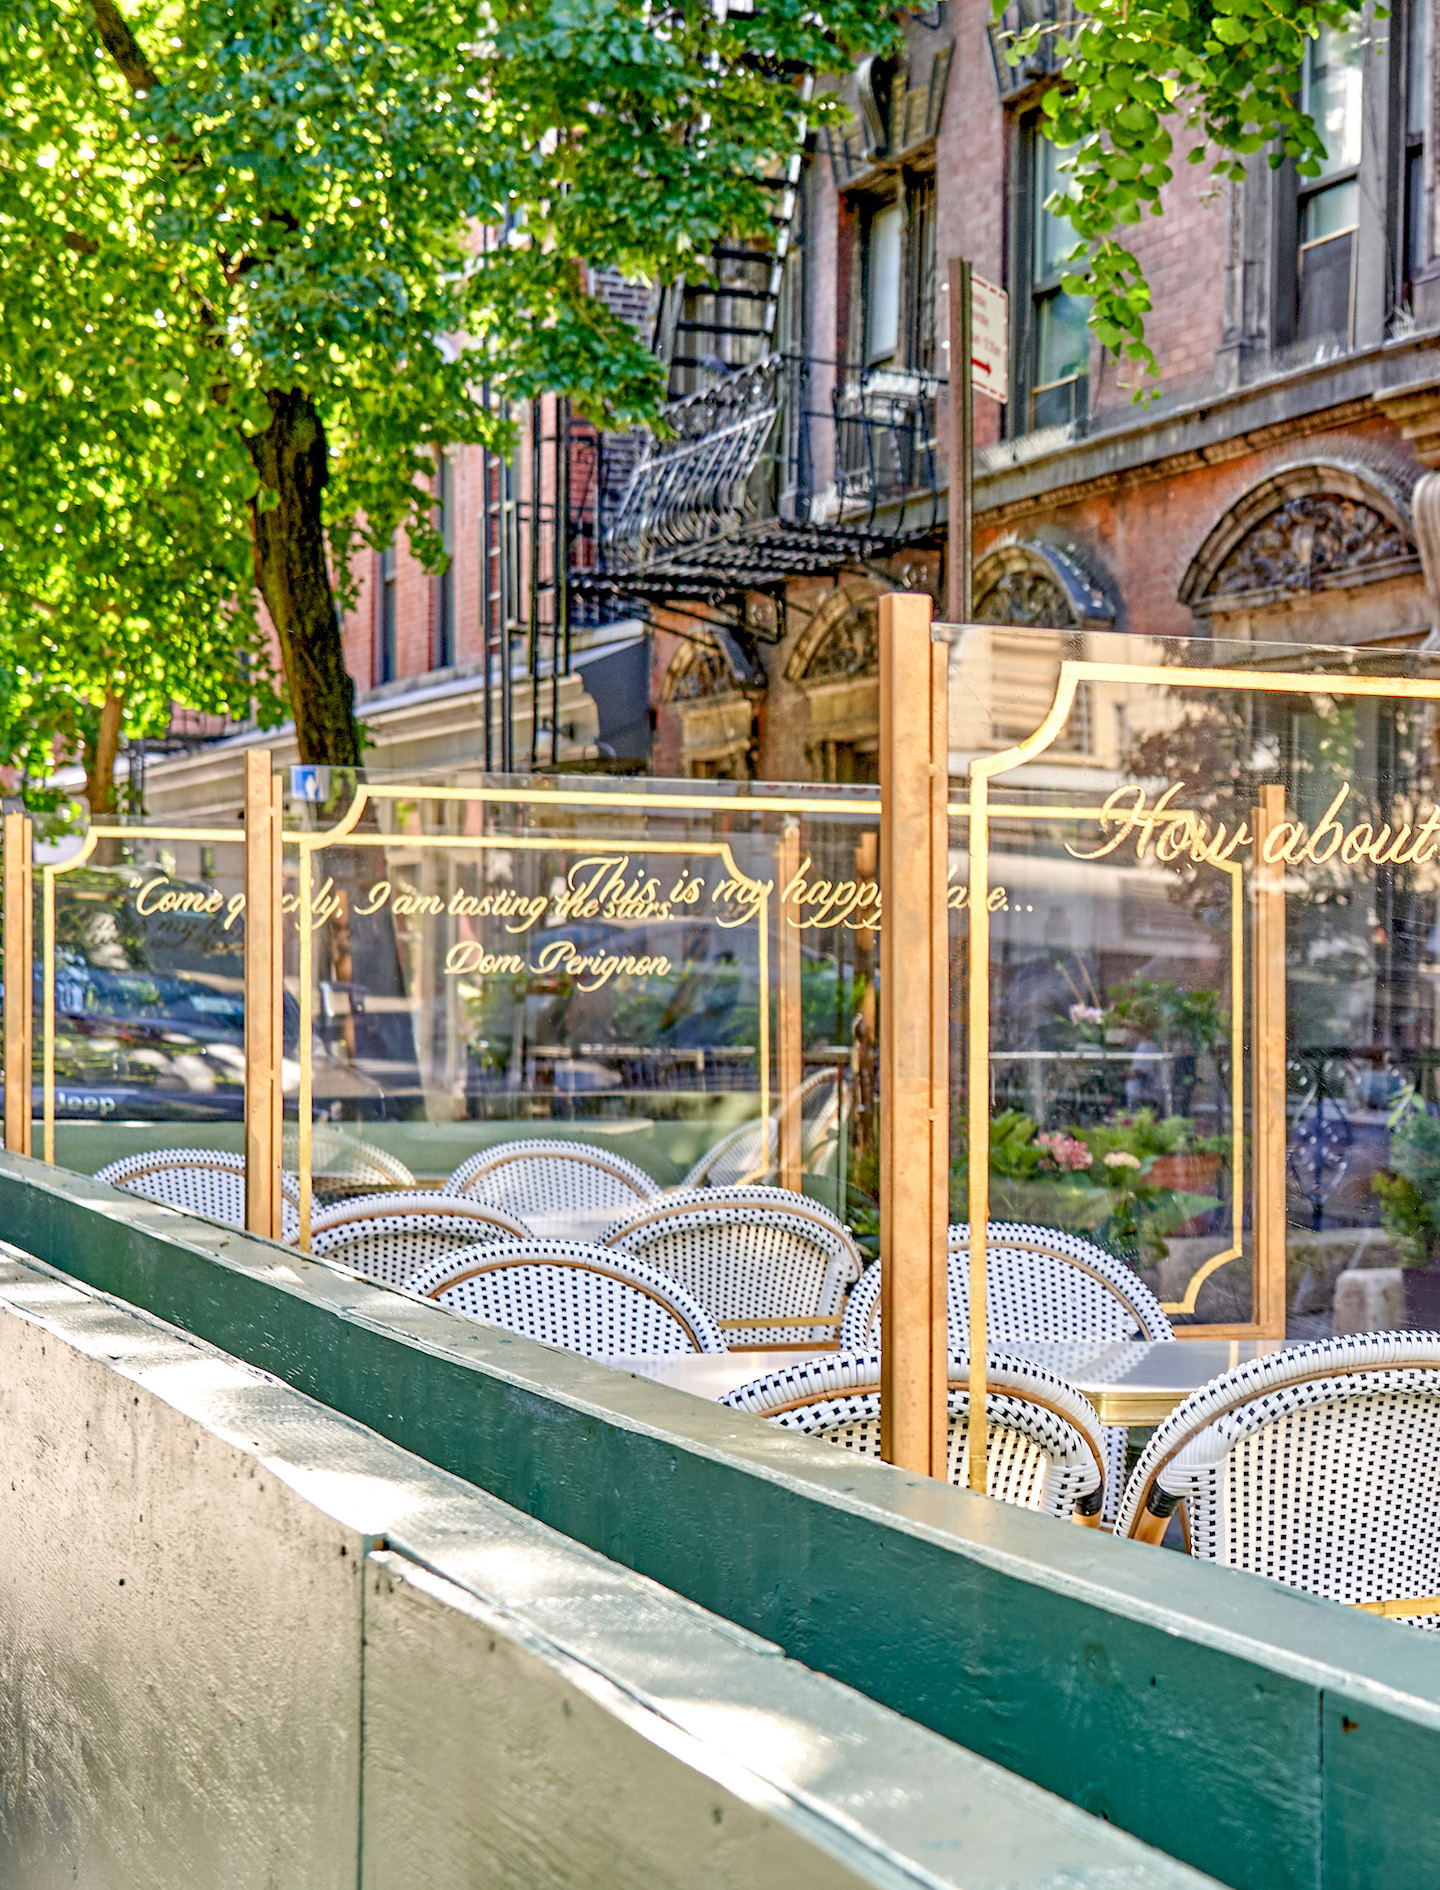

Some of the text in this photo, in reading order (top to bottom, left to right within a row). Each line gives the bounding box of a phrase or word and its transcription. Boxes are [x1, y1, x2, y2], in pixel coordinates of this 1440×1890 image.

[1064, 781, 1254, 863] How
[354, 881, 392, 915] I
[392, 894, 445, 916] am
[447, 887, 549, 935] tasting
[553, 882, 600, 919] the
[602, 896, 675, 920] stars.
[567, 855, 662, 904] This
[669, 868, 706, 905] is
[711, 878, 775, 929] my
[444, 940, 673, 993] Dom Perignon
